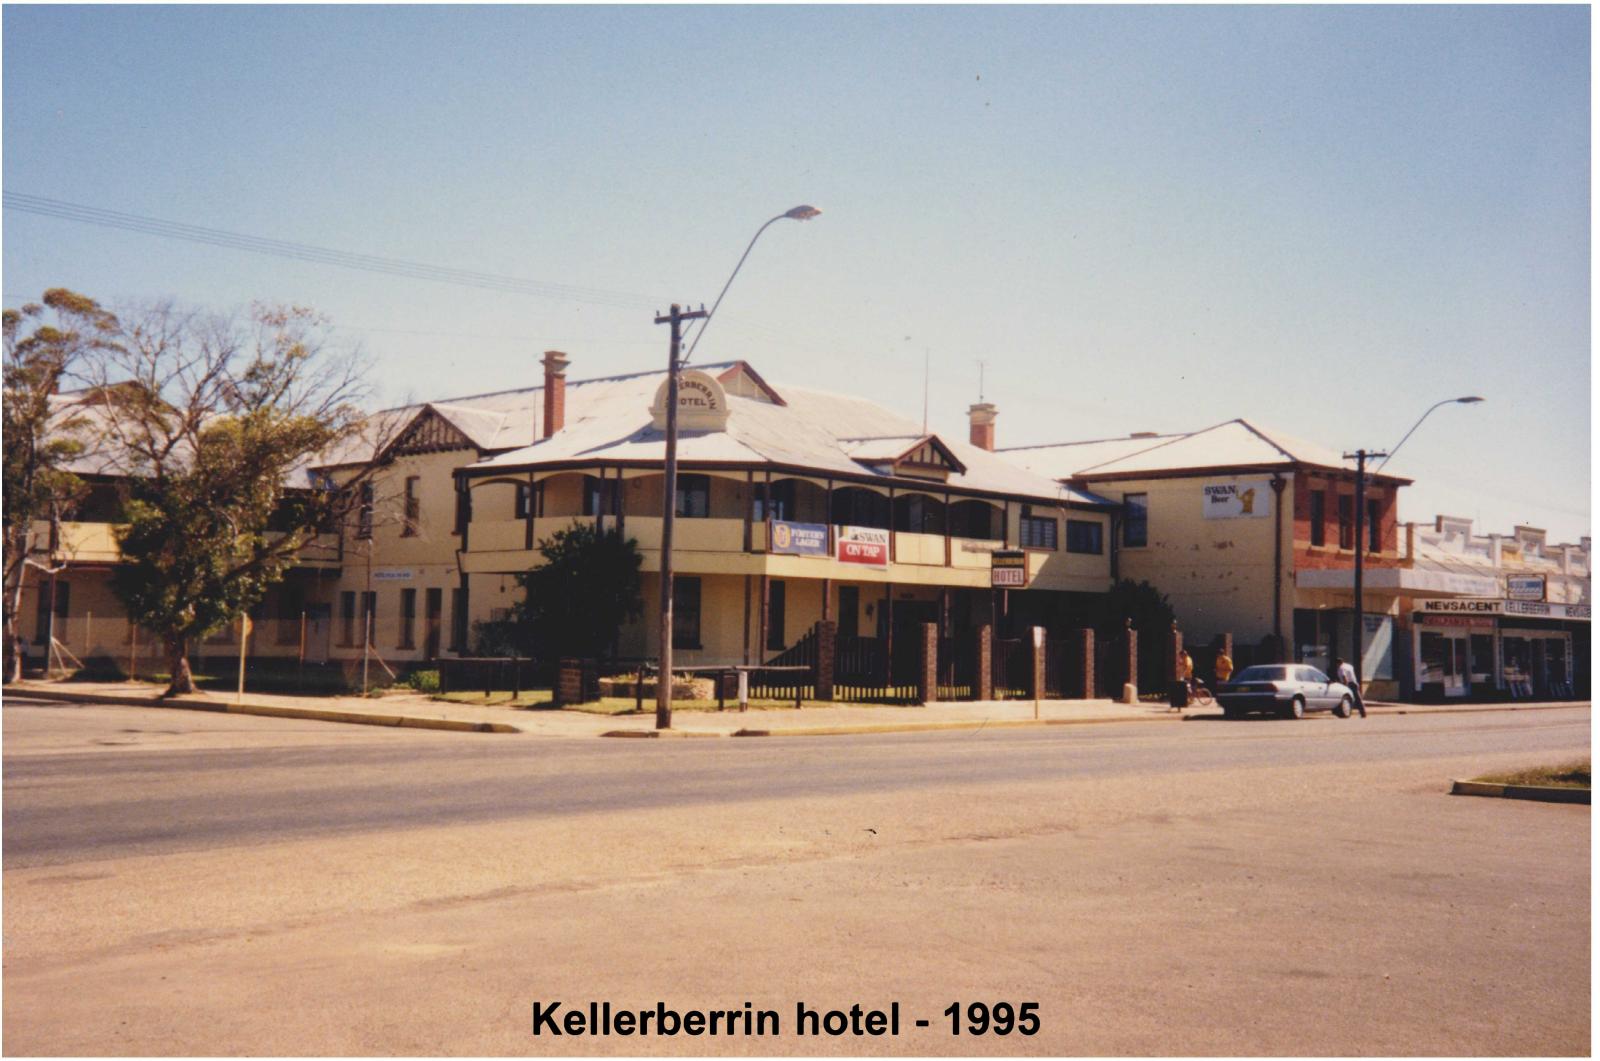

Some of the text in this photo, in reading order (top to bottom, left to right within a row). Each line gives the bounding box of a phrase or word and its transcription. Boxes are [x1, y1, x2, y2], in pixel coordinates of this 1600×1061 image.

[672, 398, 707, 406] OTEL
[1204, 485, 1236, 496] SWAN
[1211, 495, 1229, 504] Beer
[795, 538, 821, 548] LAGER
[859, 531, 887, 544] SWAN
[846, 544, 881, 558] ON TAP
[994, 570, 1024, 583] HOTEL
[1425, 601, 1502, 612] NEWSAGENT
